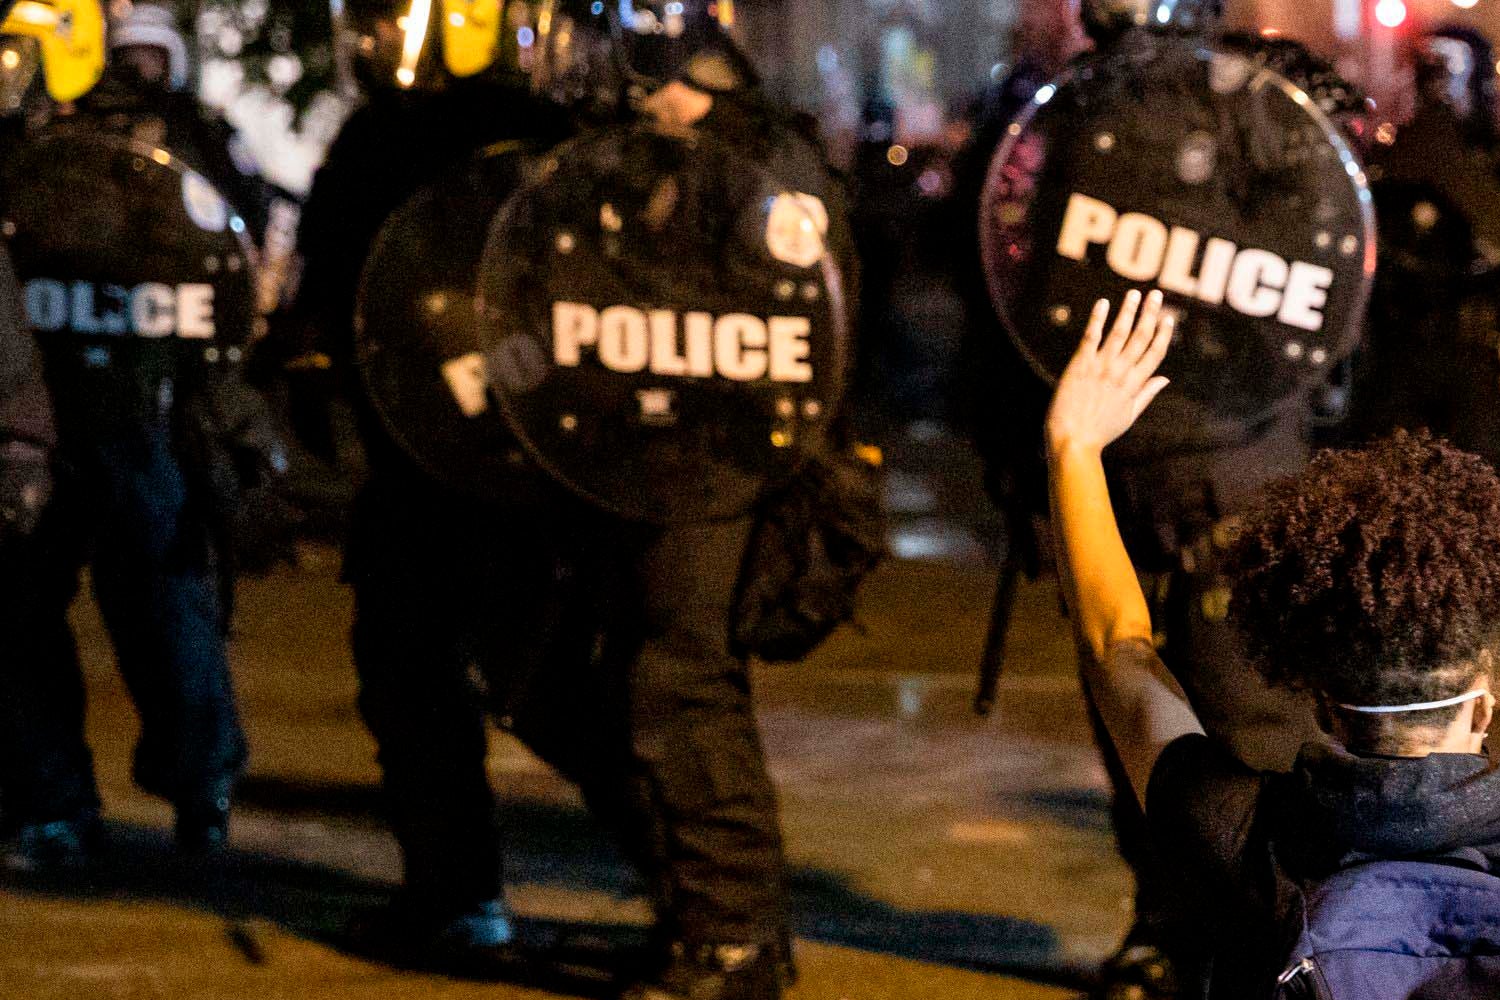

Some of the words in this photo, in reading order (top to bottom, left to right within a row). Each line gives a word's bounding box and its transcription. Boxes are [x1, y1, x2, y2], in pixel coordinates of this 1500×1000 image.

[1056, 193, 1334, 332] POLICE
[23, 279, 217, 340] OLICE
[552, 301, 814, 384] POLICE
